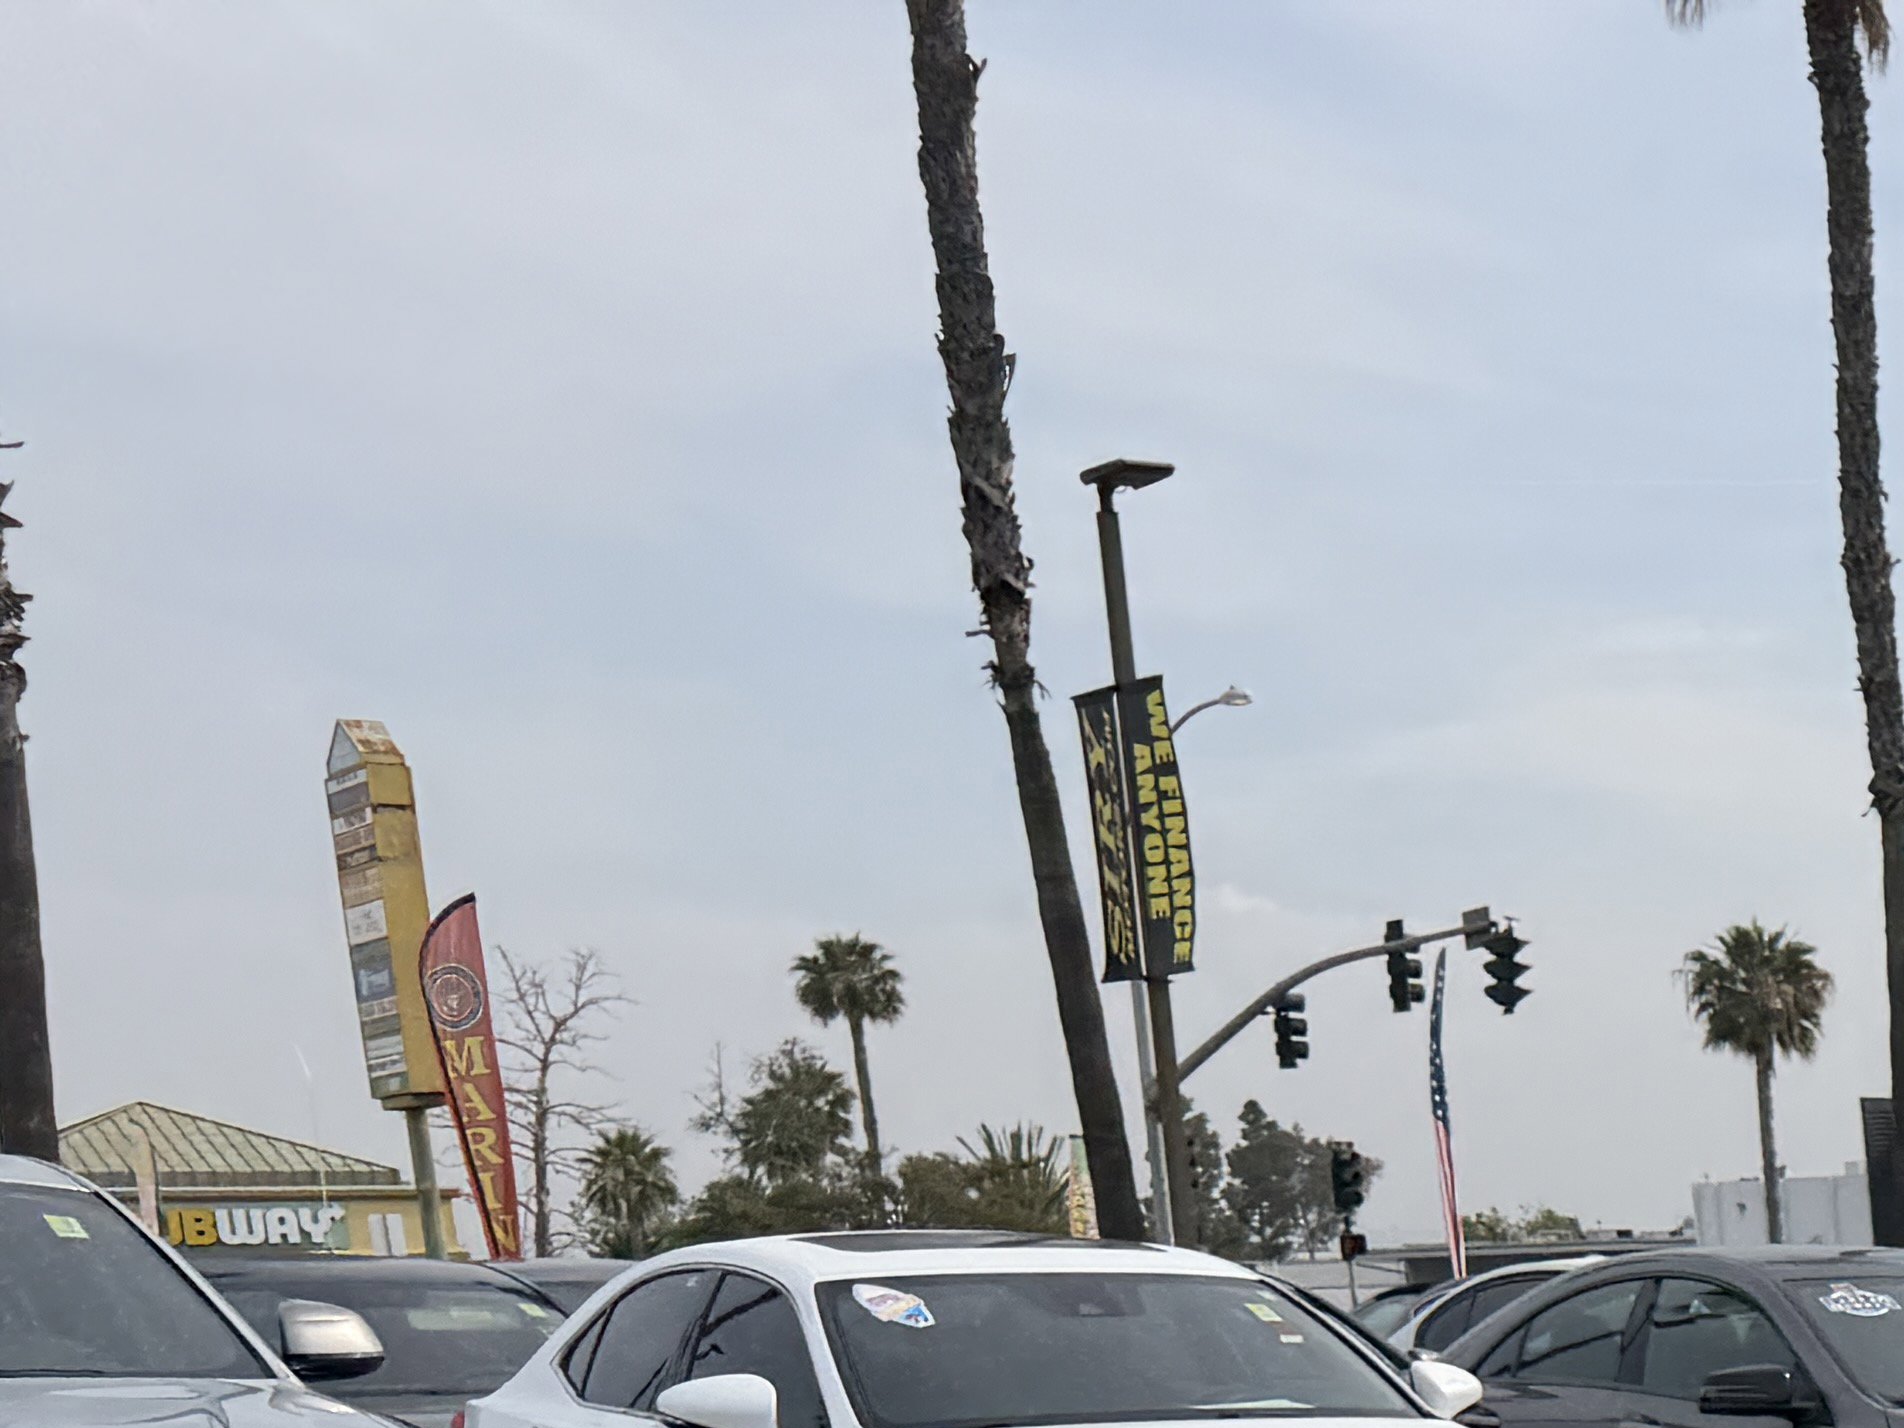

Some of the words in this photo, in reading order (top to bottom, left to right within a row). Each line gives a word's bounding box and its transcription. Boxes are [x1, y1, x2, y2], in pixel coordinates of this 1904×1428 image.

[1147, 689, 1174, 764] WE
[1133, 743, 1171, 920] ANYONE
[1158, 776, 1192, 964] FINANCE
[164, 1202, 346, 1247] BWAY
